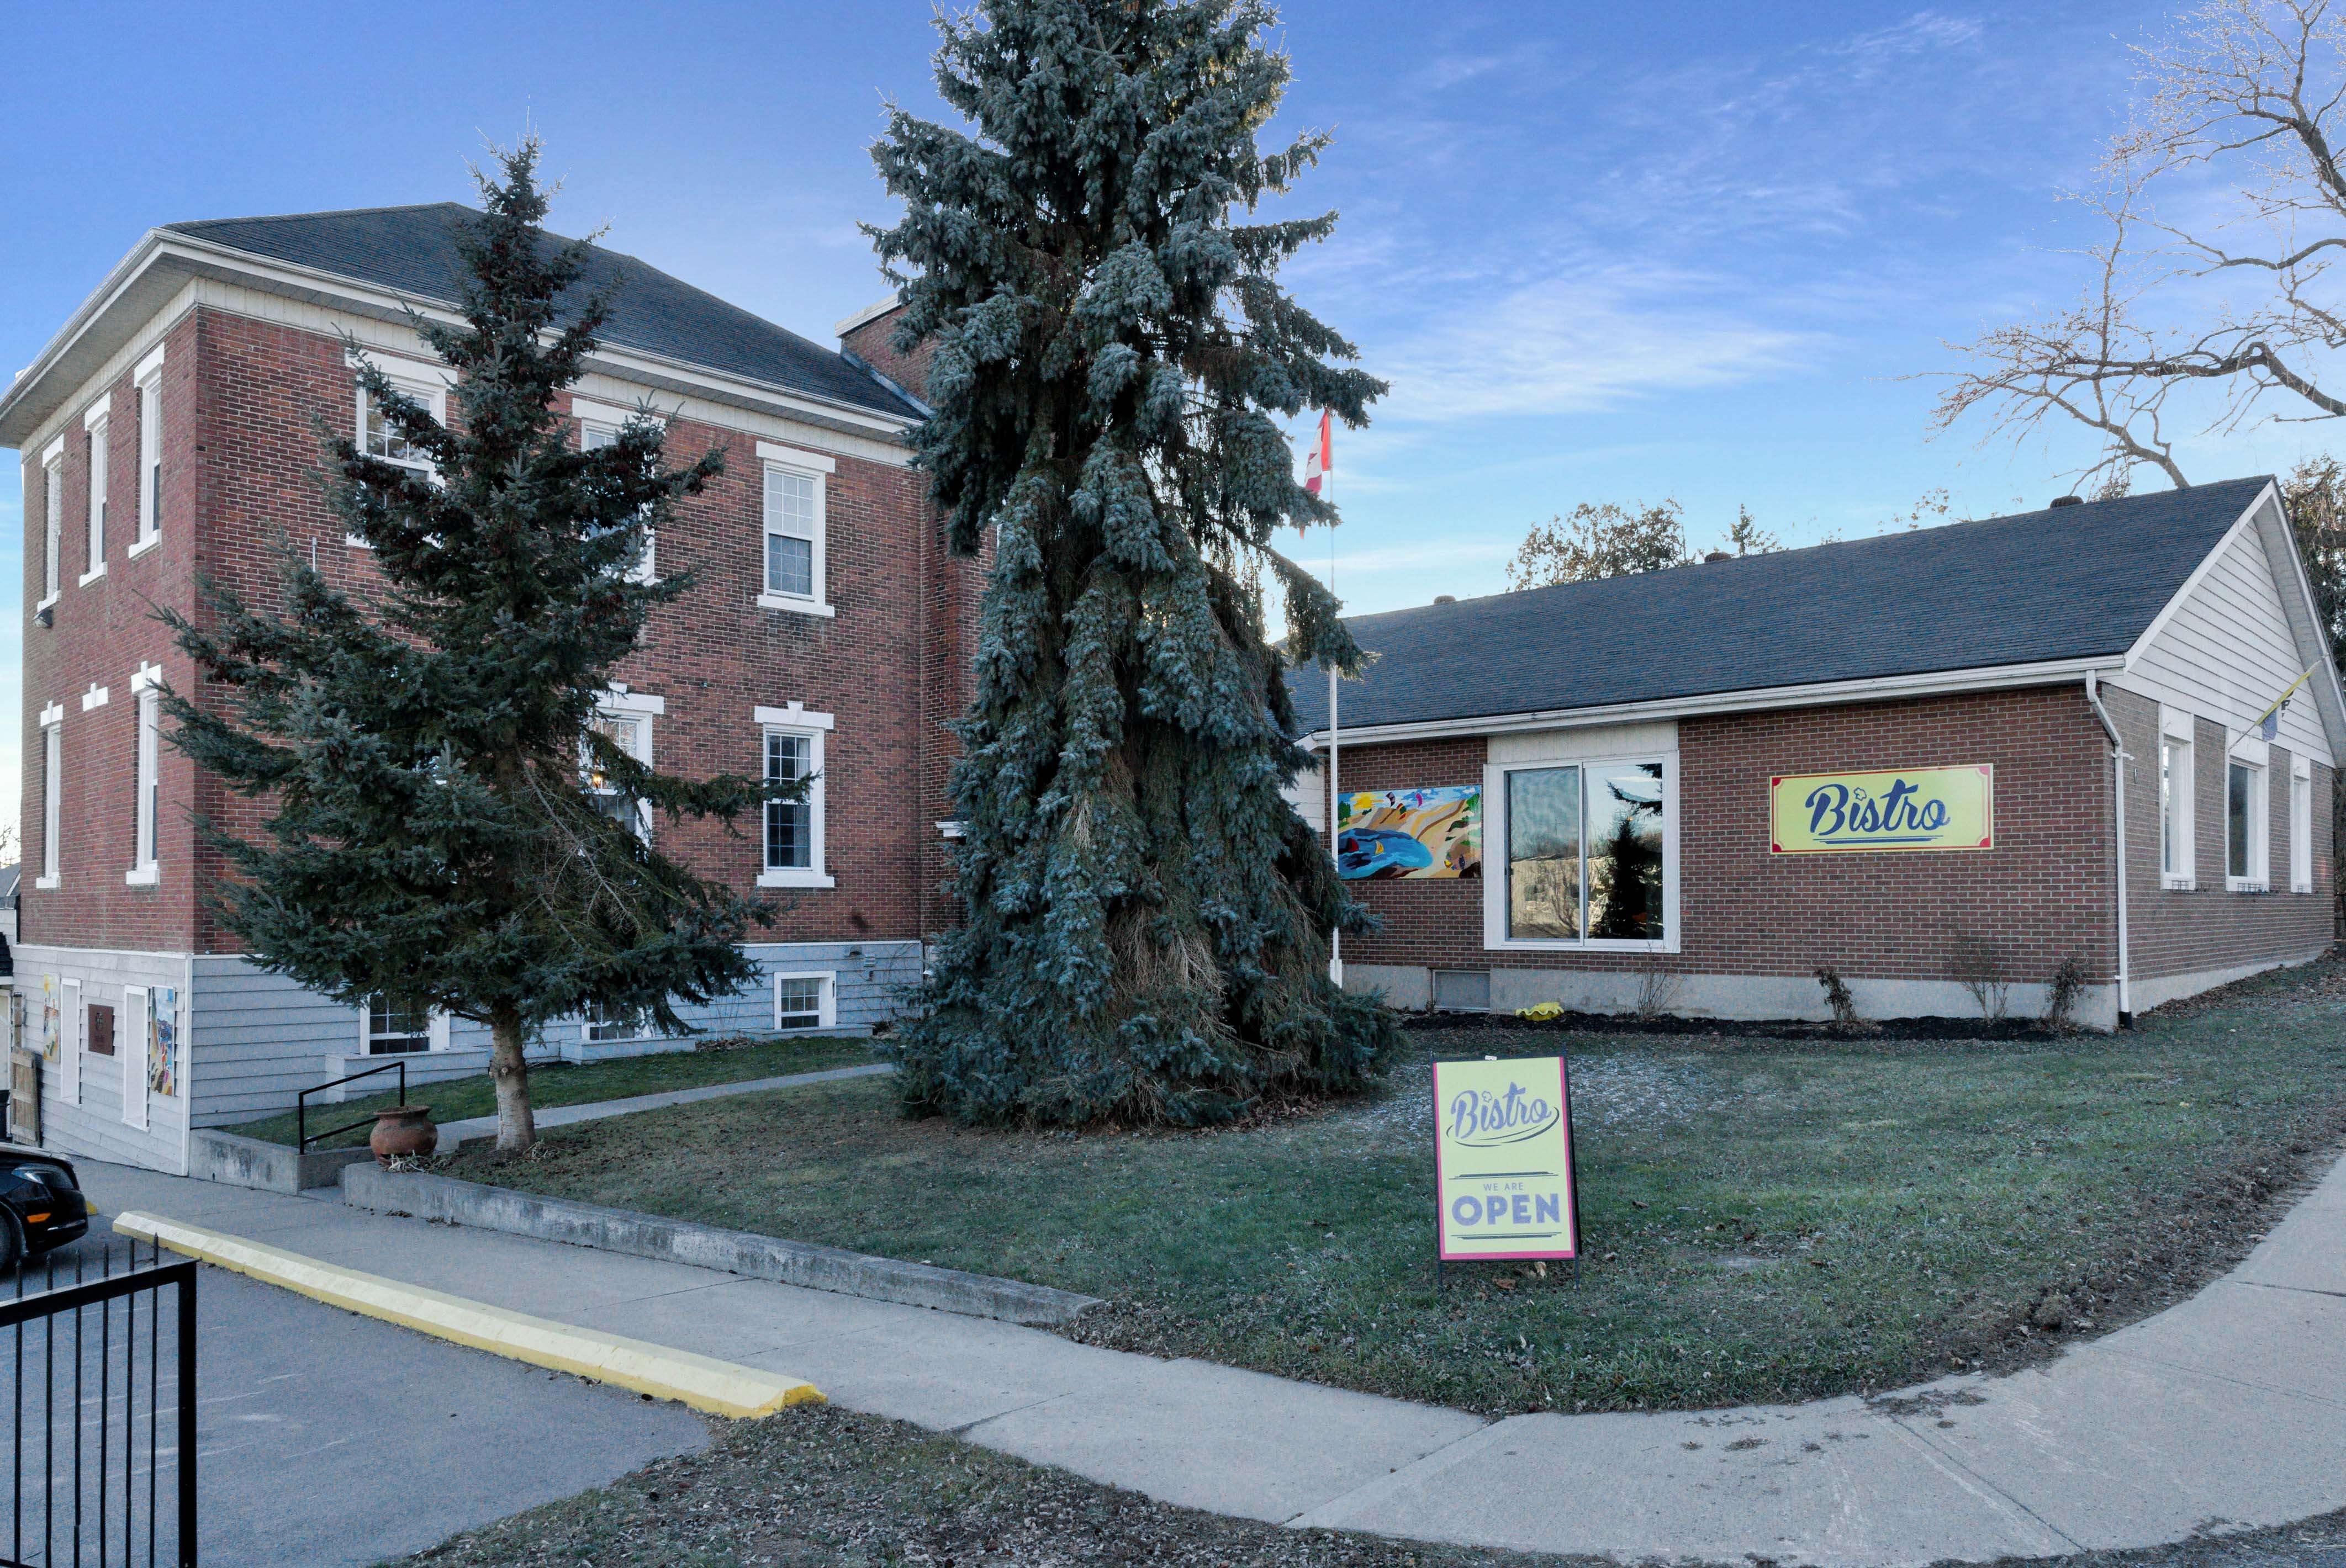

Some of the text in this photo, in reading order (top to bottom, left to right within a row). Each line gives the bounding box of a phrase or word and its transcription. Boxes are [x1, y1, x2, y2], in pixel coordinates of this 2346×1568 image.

[1805, 778, 1951, 836] Bistro
[1450, 1082, 1552, 1140] Bistro
[1483, 1182, 1524, 1191] WE ARE
[1451, 1193, 1561, 1226] OPEN
